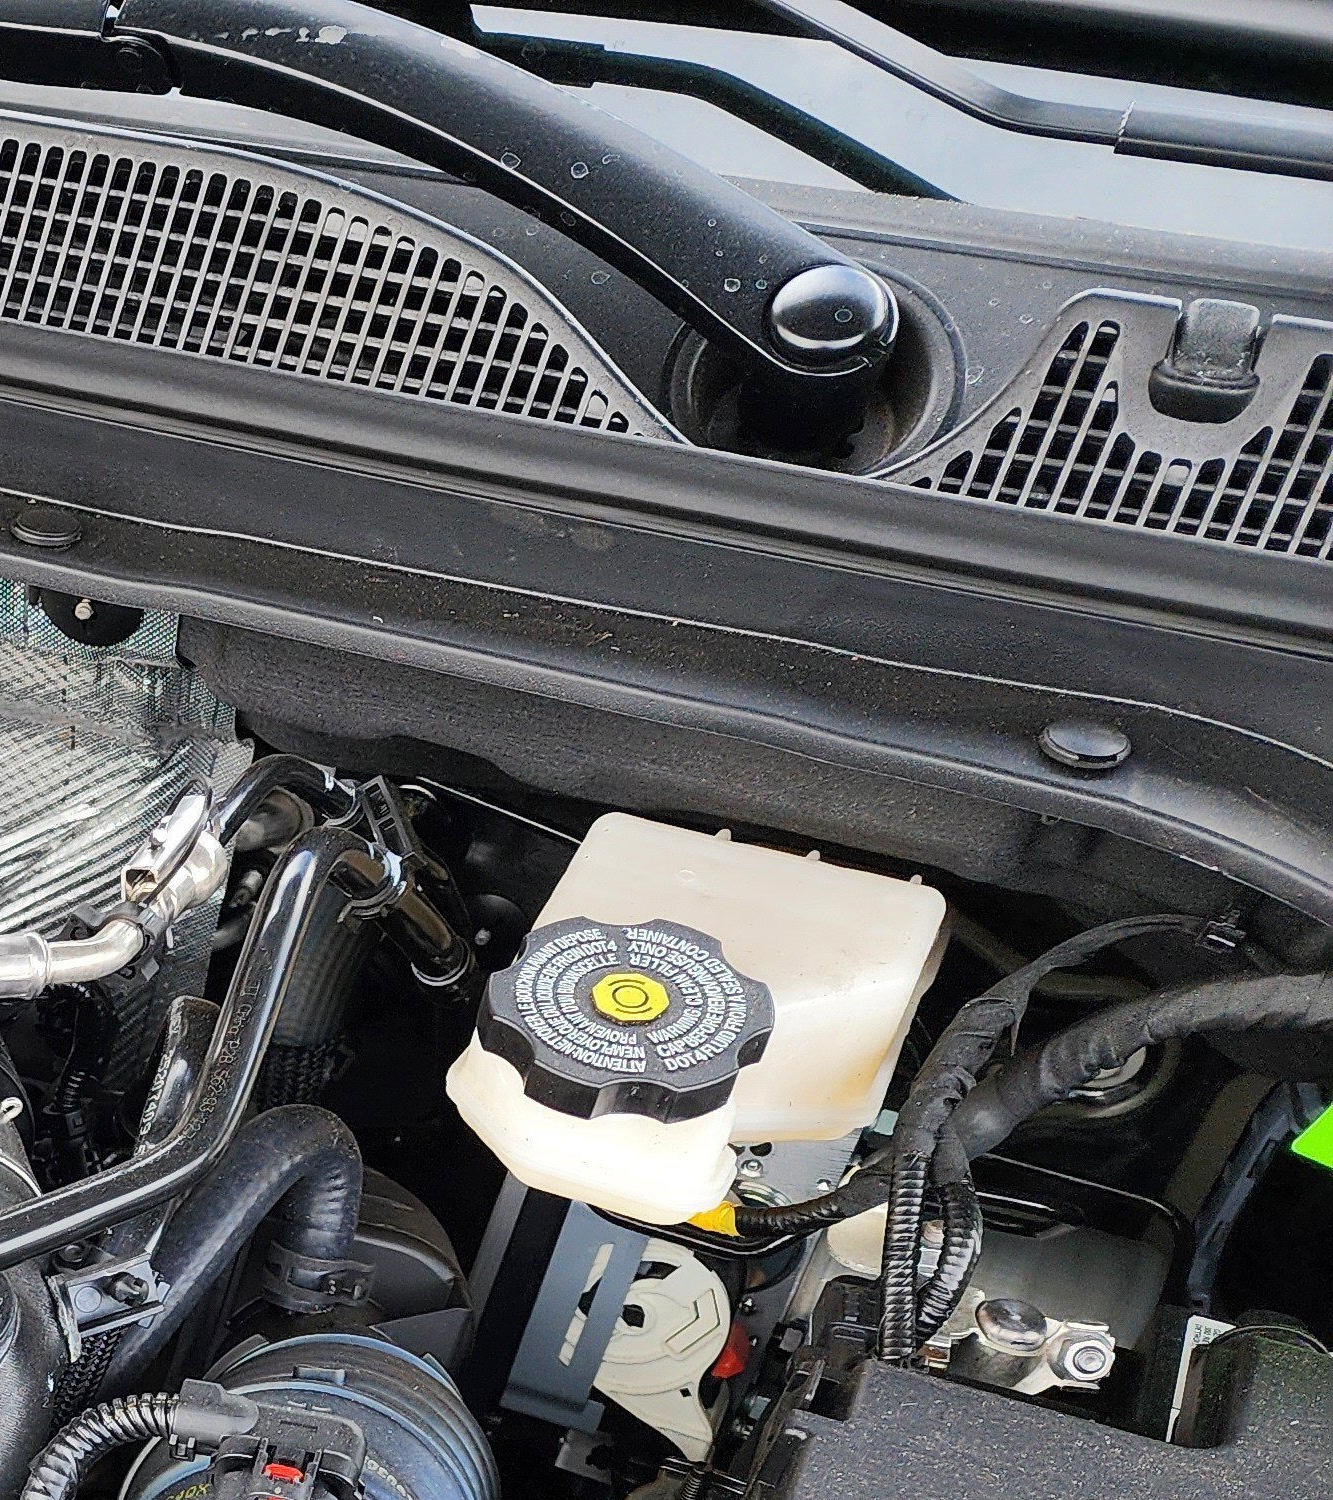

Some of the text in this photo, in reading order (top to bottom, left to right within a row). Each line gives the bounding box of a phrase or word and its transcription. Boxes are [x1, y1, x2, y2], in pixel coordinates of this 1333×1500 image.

[626, 941, 667, 957] ONLY
[673, 973, 703, 1006] CLEAN
[704, 959, 744, 995] SEALED
[682, 1013, 723, 1048] BEFORE
[655, 1039, 686, 1058] CAP
